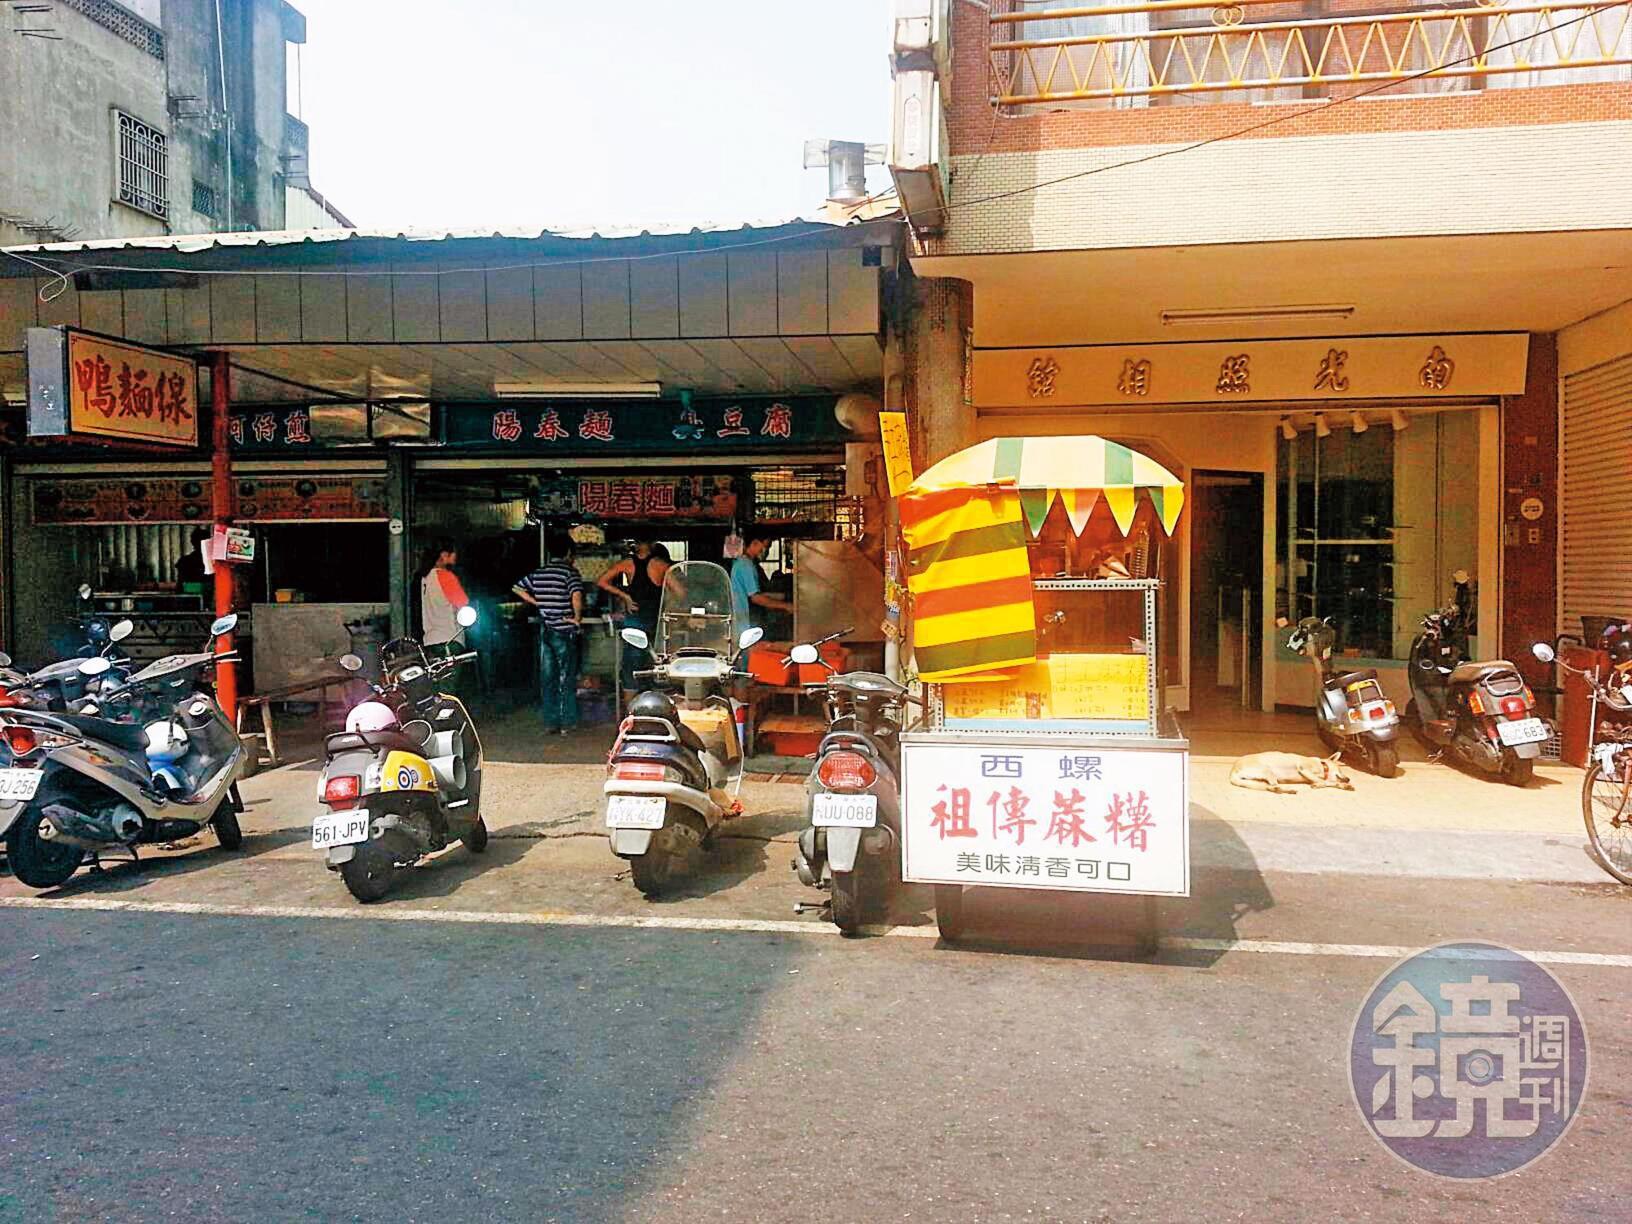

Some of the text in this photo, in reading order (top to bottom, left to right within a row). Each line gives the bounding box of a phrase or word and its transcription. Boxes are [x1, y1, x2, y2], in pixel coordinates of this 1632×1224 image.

[980, 754, 1103, 780] 西螺
[315, 820, 366, 843] 561-JPV
[956, 852, 1132, 882] 美味清香可口
